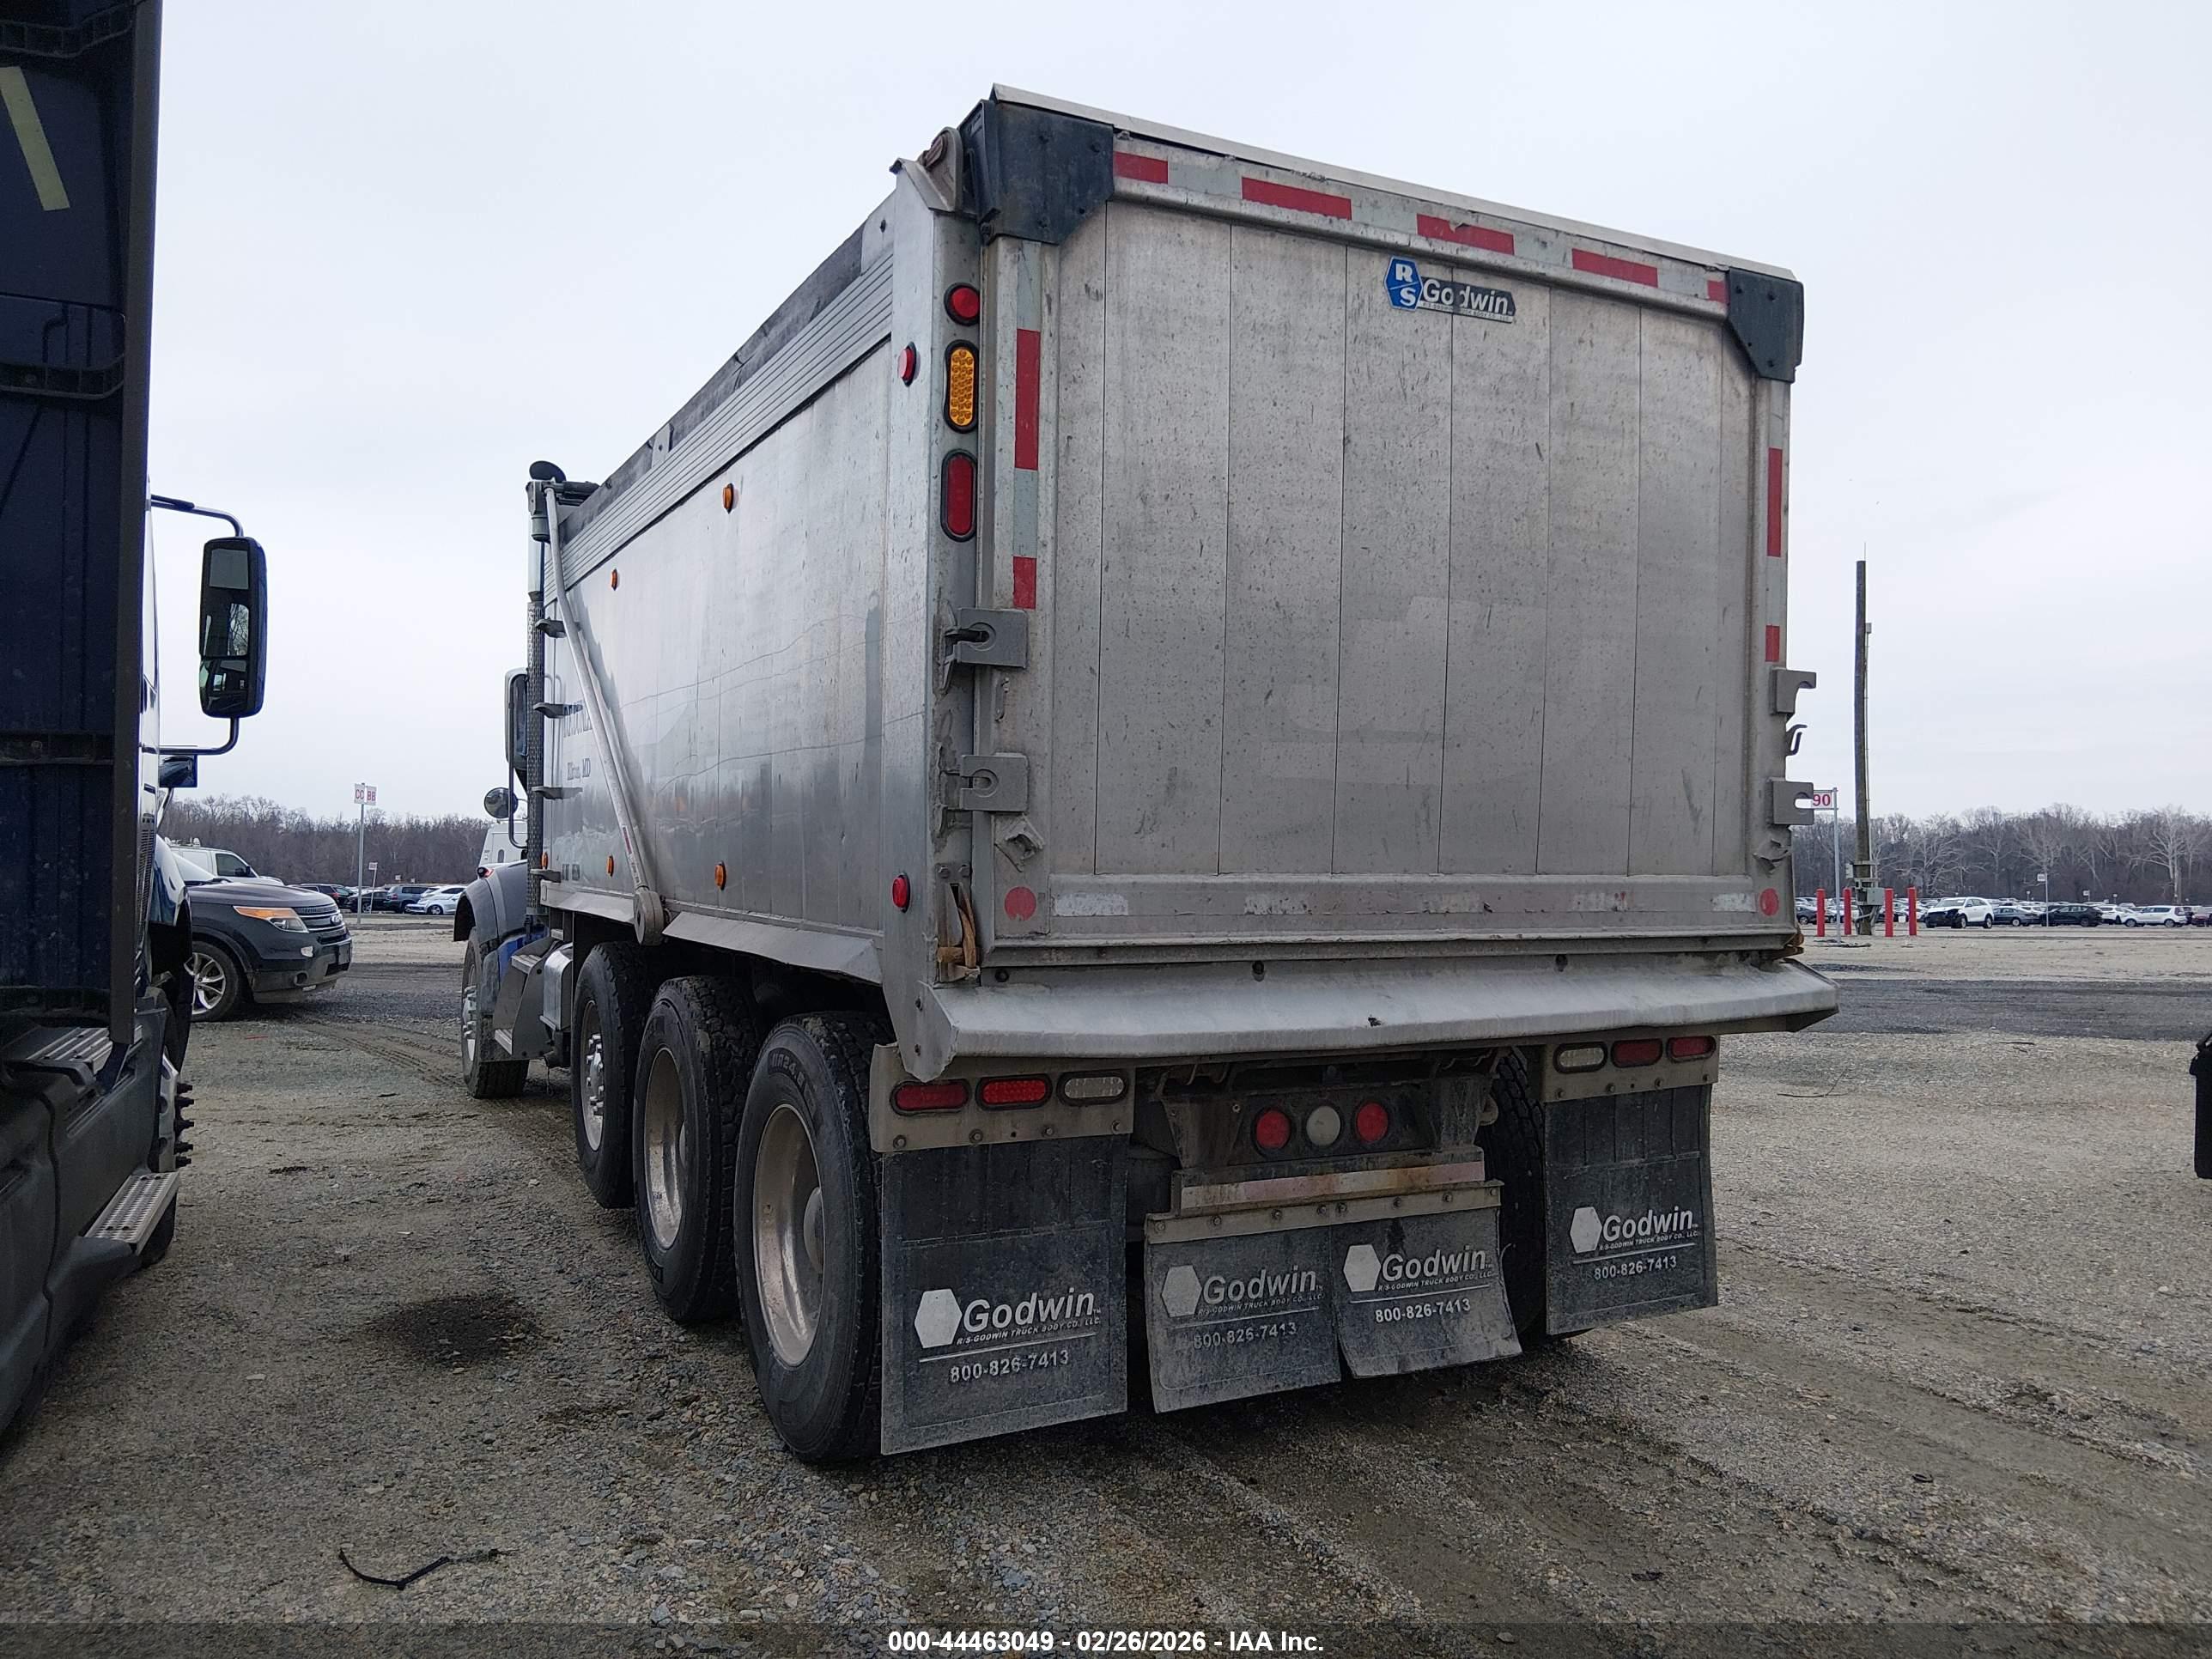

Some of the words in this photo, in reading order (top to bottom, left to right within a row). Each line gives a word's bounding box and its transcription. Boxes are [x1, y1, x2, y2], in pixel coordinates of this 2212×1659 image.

[1395, 263, 1413, 282] R
[1400, 287, 1417, 307] S
[1423, 279, 1509, 316] Godwin
[1602, 1206, 1693, 1242] Godwin
[1382, 1245, 1486, 1281] Godwin
[1594, 1255, 1677, 1280] 800-826-7413
[1203, 1265, 1316, 1304] Godwin
[963, 1287, 1096, 1333] Godwin
[1375, 1297, 1471, 1323] 800-826-7413
[1011, 1327, 1039, 1337] TRUCK
[1194, 1322, 1297, 1349] 800-826-7413
[950, 1349, 1069, 1382] 800-826-7413
